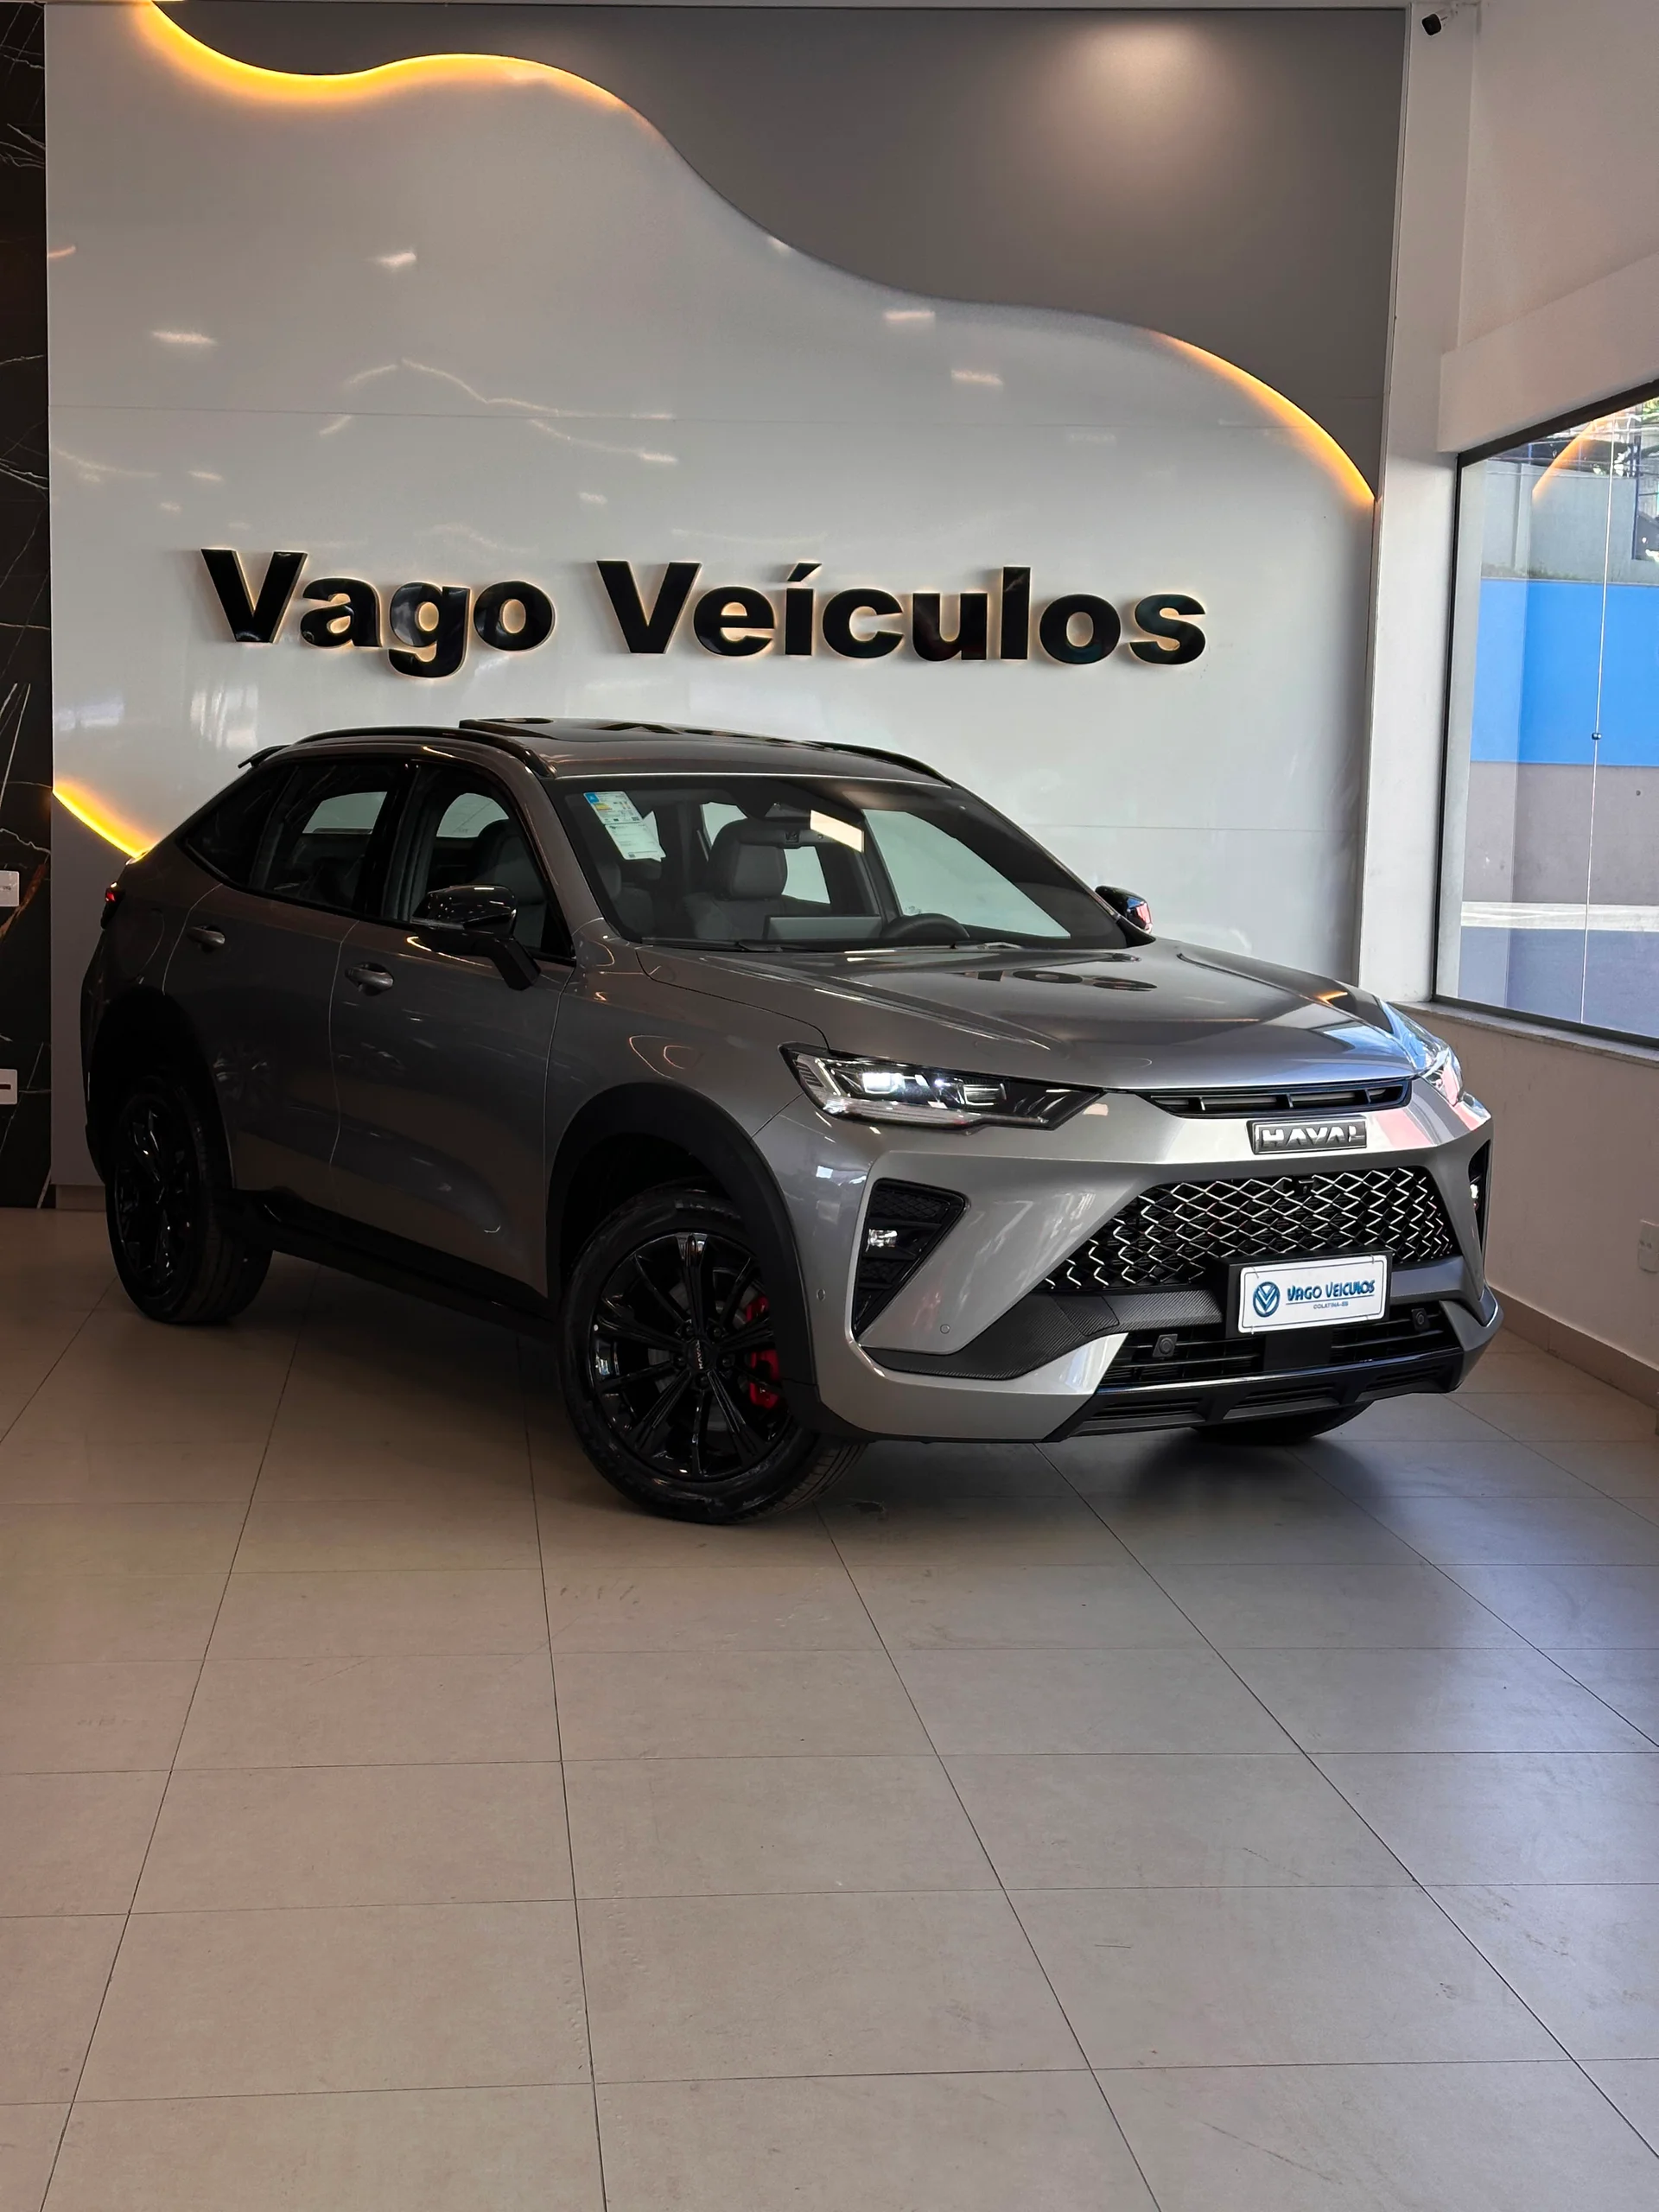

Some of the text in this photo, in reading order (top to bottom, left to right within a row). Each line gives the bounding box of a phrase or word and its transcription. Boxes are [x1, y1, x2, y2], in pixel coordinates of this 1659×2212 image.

[200, 548, 1207, 678] Vago Veículos
[1262, 1125, 1366, 1148] HAVAL
[1287, 1280, 1376, 1302] VAGO VEICULOS
